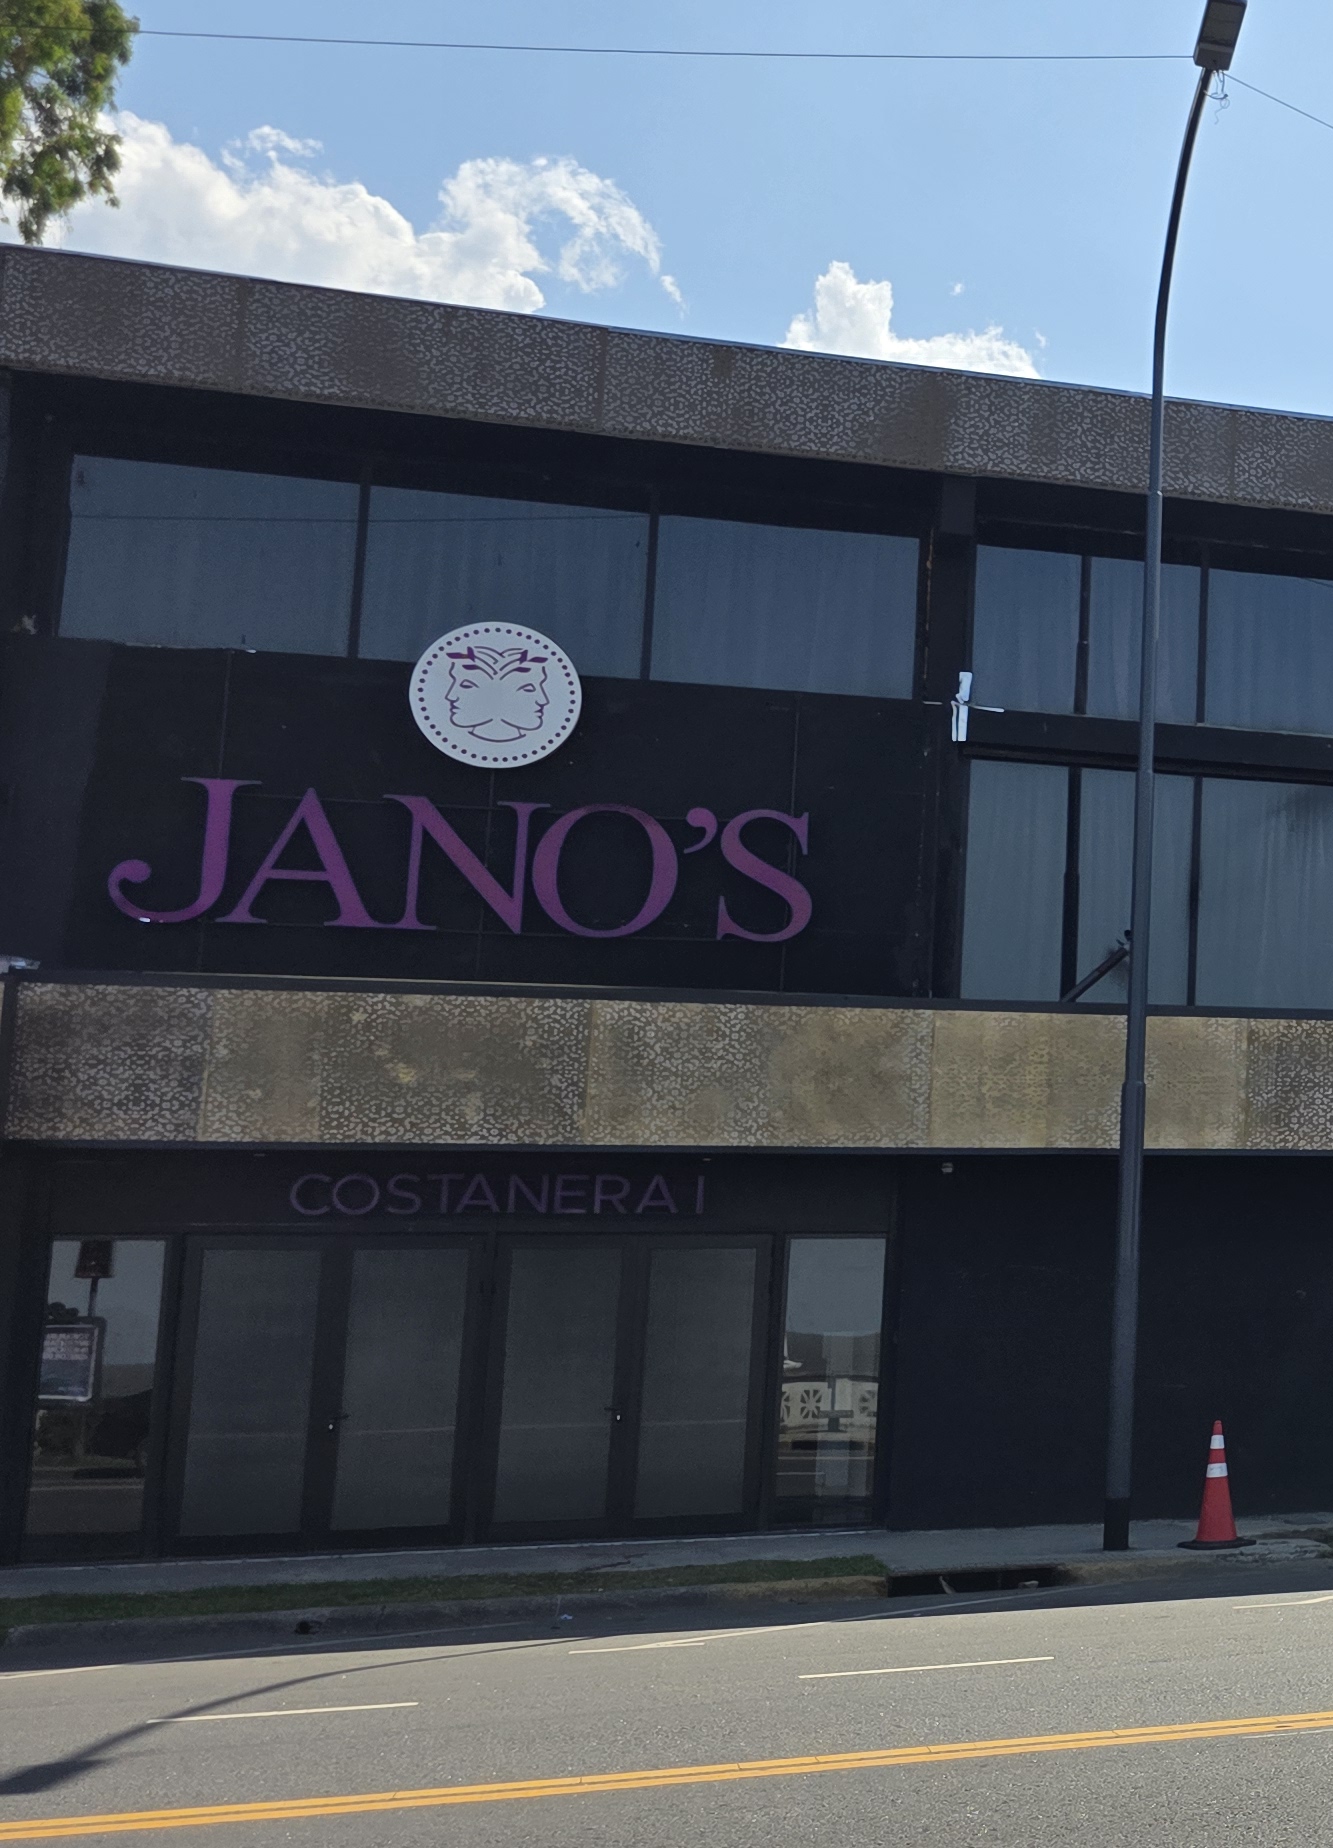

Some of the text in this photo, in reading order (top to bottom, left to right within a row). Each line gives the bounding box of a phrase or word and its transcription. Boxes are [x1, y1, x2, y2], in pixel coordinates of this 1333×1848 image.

[107, 777, 813, 943] JANO'S
[289, 1172, 705, 1215] COSTANERA I
